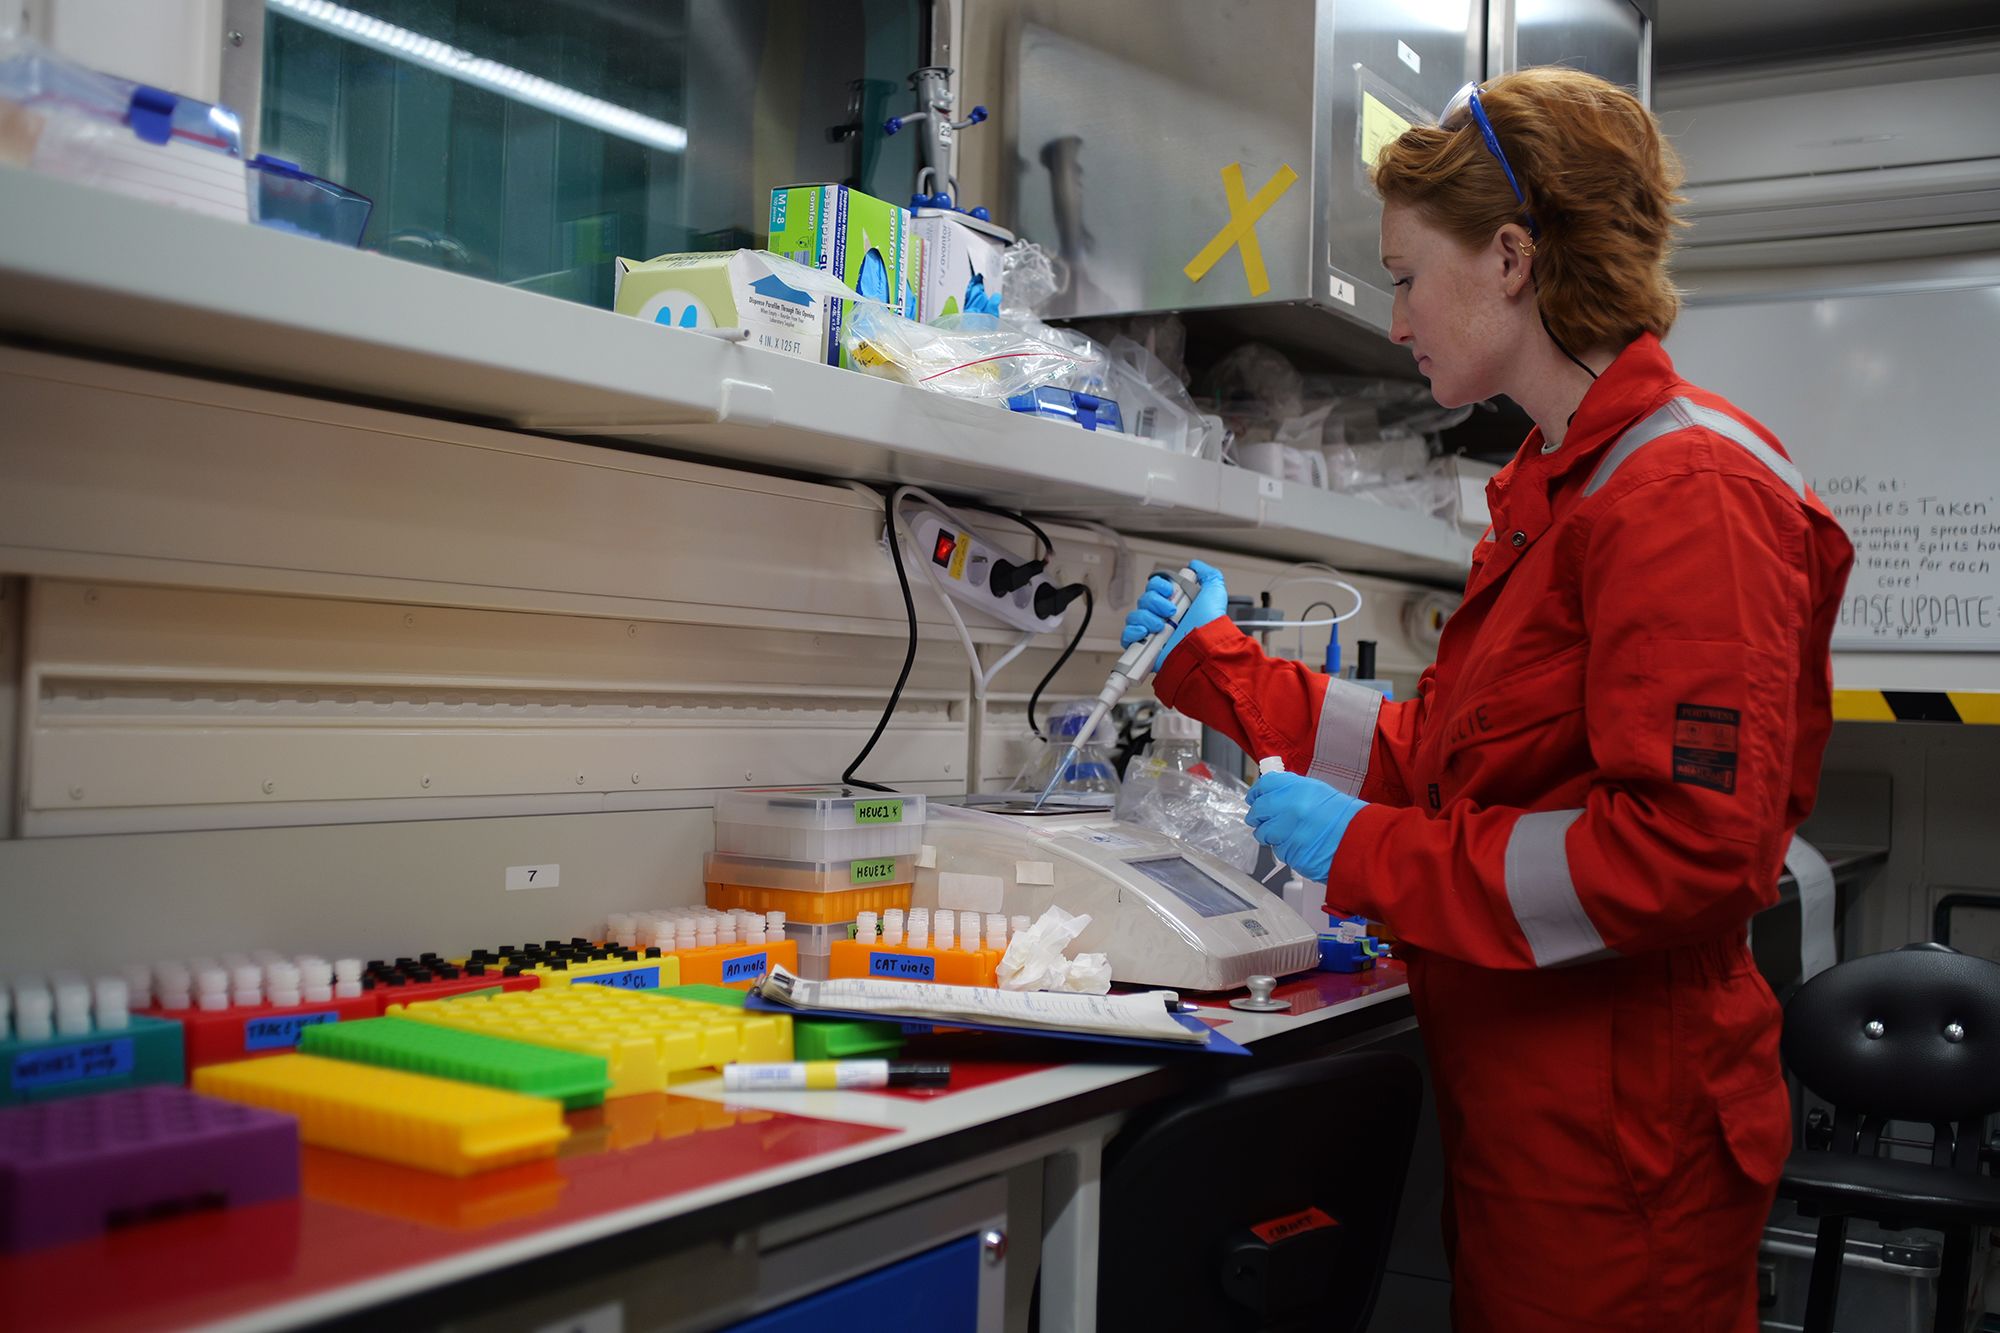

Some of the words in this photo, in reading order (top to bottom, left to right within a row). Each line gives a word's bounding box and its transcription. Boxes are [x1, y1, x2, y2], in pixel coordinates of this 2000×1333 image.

[777, 193, 787, 205] M
[776, 206, 787, 225] 7-8
[808, 190, 816, 231] comfort
[888, 207, 897, 271] comfort
[838, 244, 846, 274] Protective
[748, 296, 765, 307] Dispense
[765, 300, 780, 310] Parafilm
[781, 304, 794, 315] Through
[802, 310, 815, 320] Opening
[759, 334, 764, 345] 4
[774, 338, 780, 349] X
[781, 338, 792, 352] 125
[1812, 475, 1868, 496] LOOK
[1825, 500, 1909, 521] amples
[1950, 560, 1990, 574] each
[1901, 594, 1994, 629] UPDATE
[527, 870, 538, 882] 7
[743, 959, 765, 974] vials
[874, 958, 898, 972] CAT
[900, 961, 931, 976] vials
